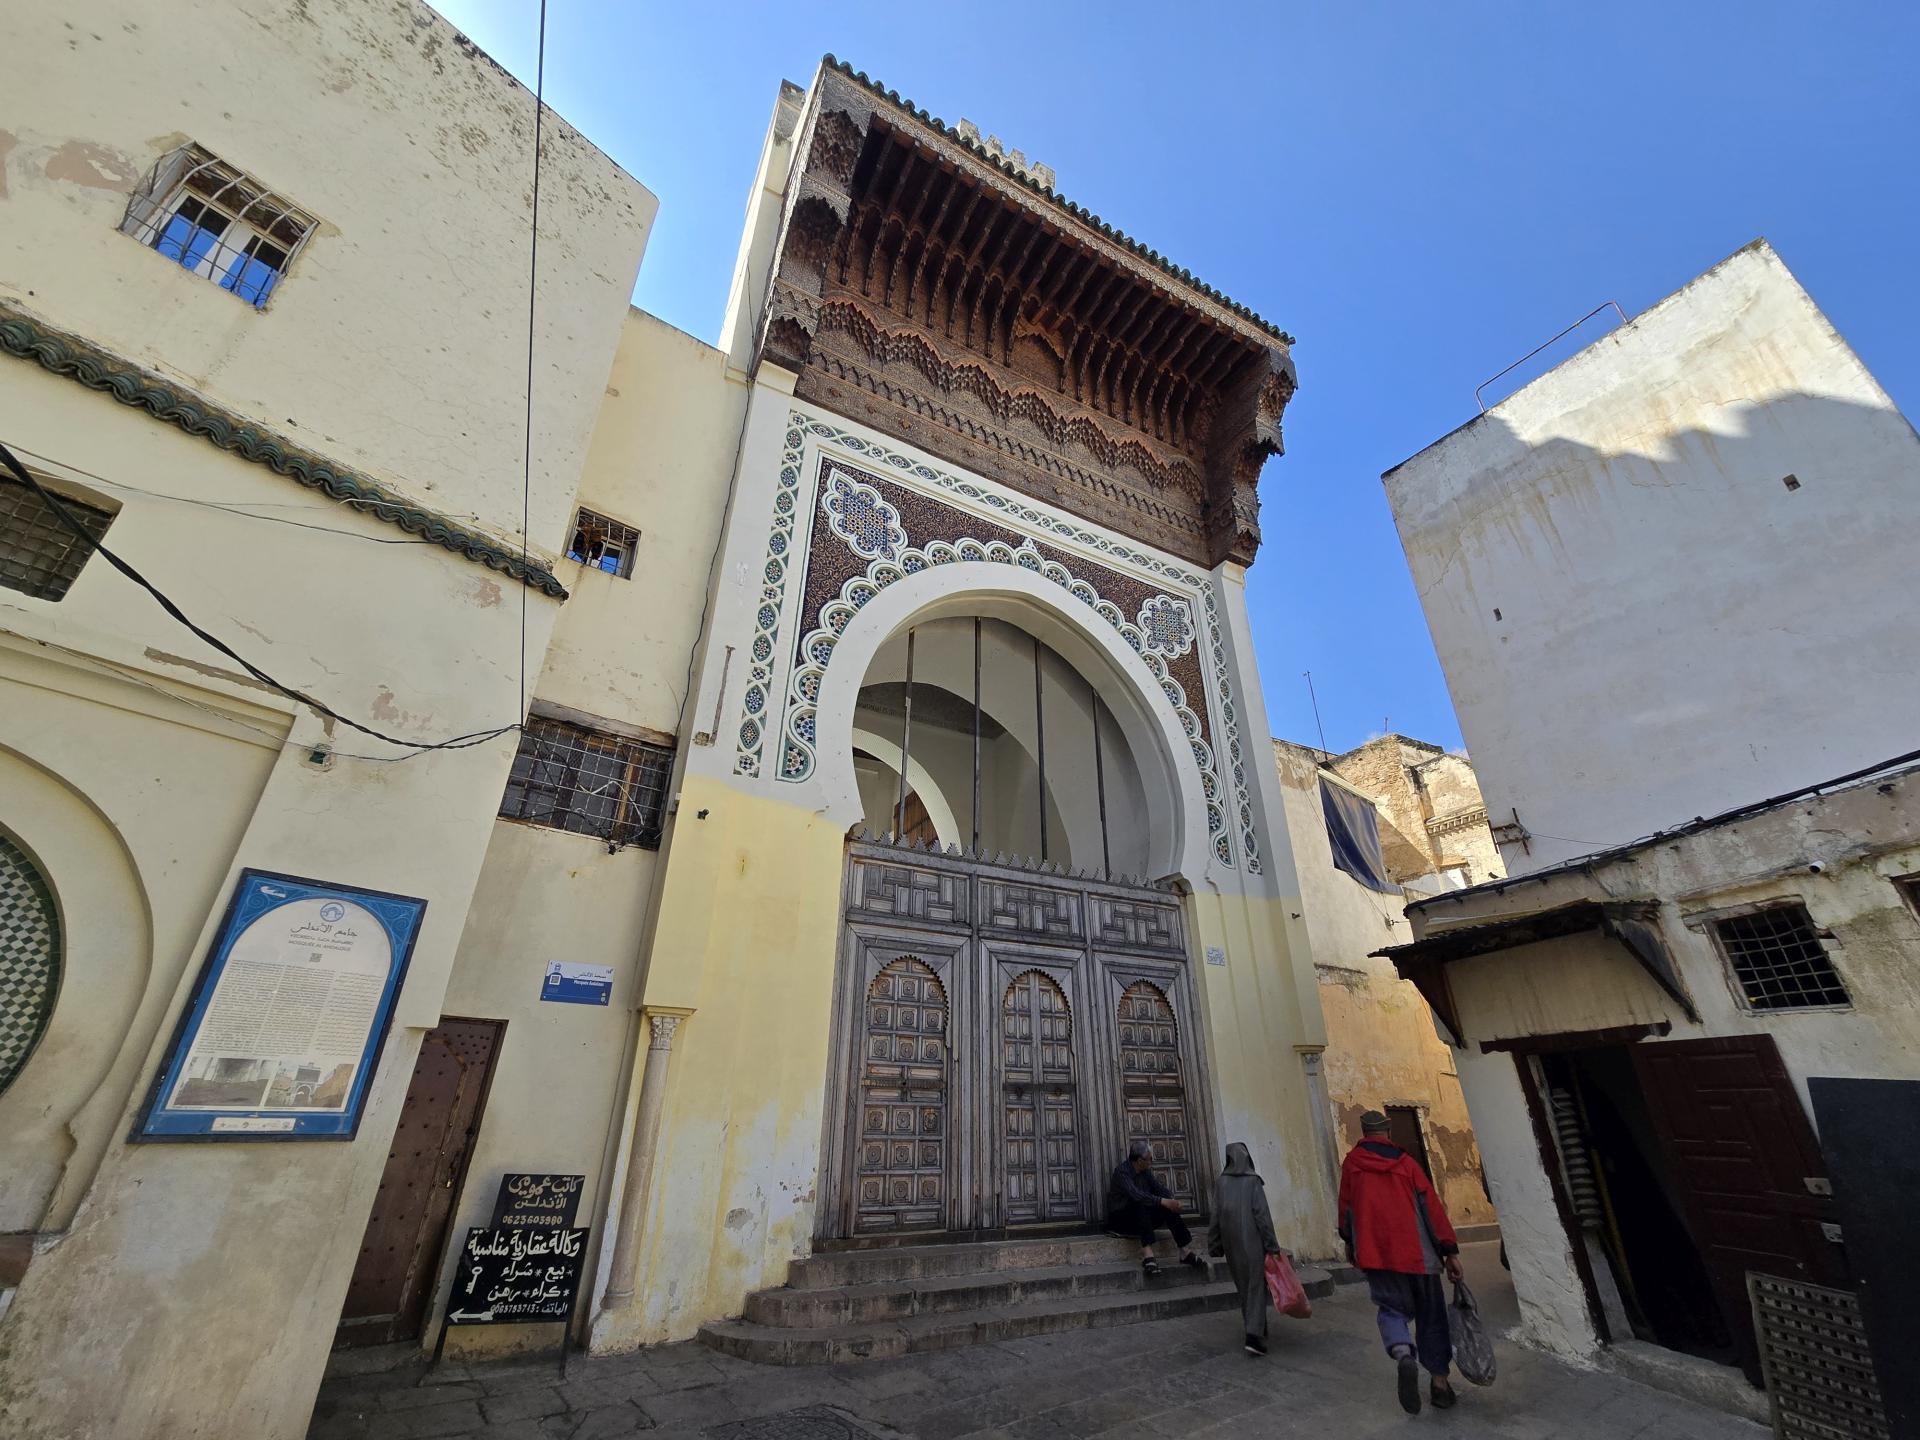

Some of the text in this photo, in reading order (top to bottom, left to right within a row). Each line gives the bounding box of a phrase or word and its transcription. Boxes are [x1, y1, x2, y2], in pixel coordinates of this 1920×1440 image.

[508, 1176, 585, 1198] كاتب عمومي
[514, 1195, 567, 1209] الأندلس
[467, 1229, 583, 1261] وكالة عقارية مناسبة
[500, 1261, 565, 1282] بيع شراء
[487, 1281, 561, 1303] كراء رهن
